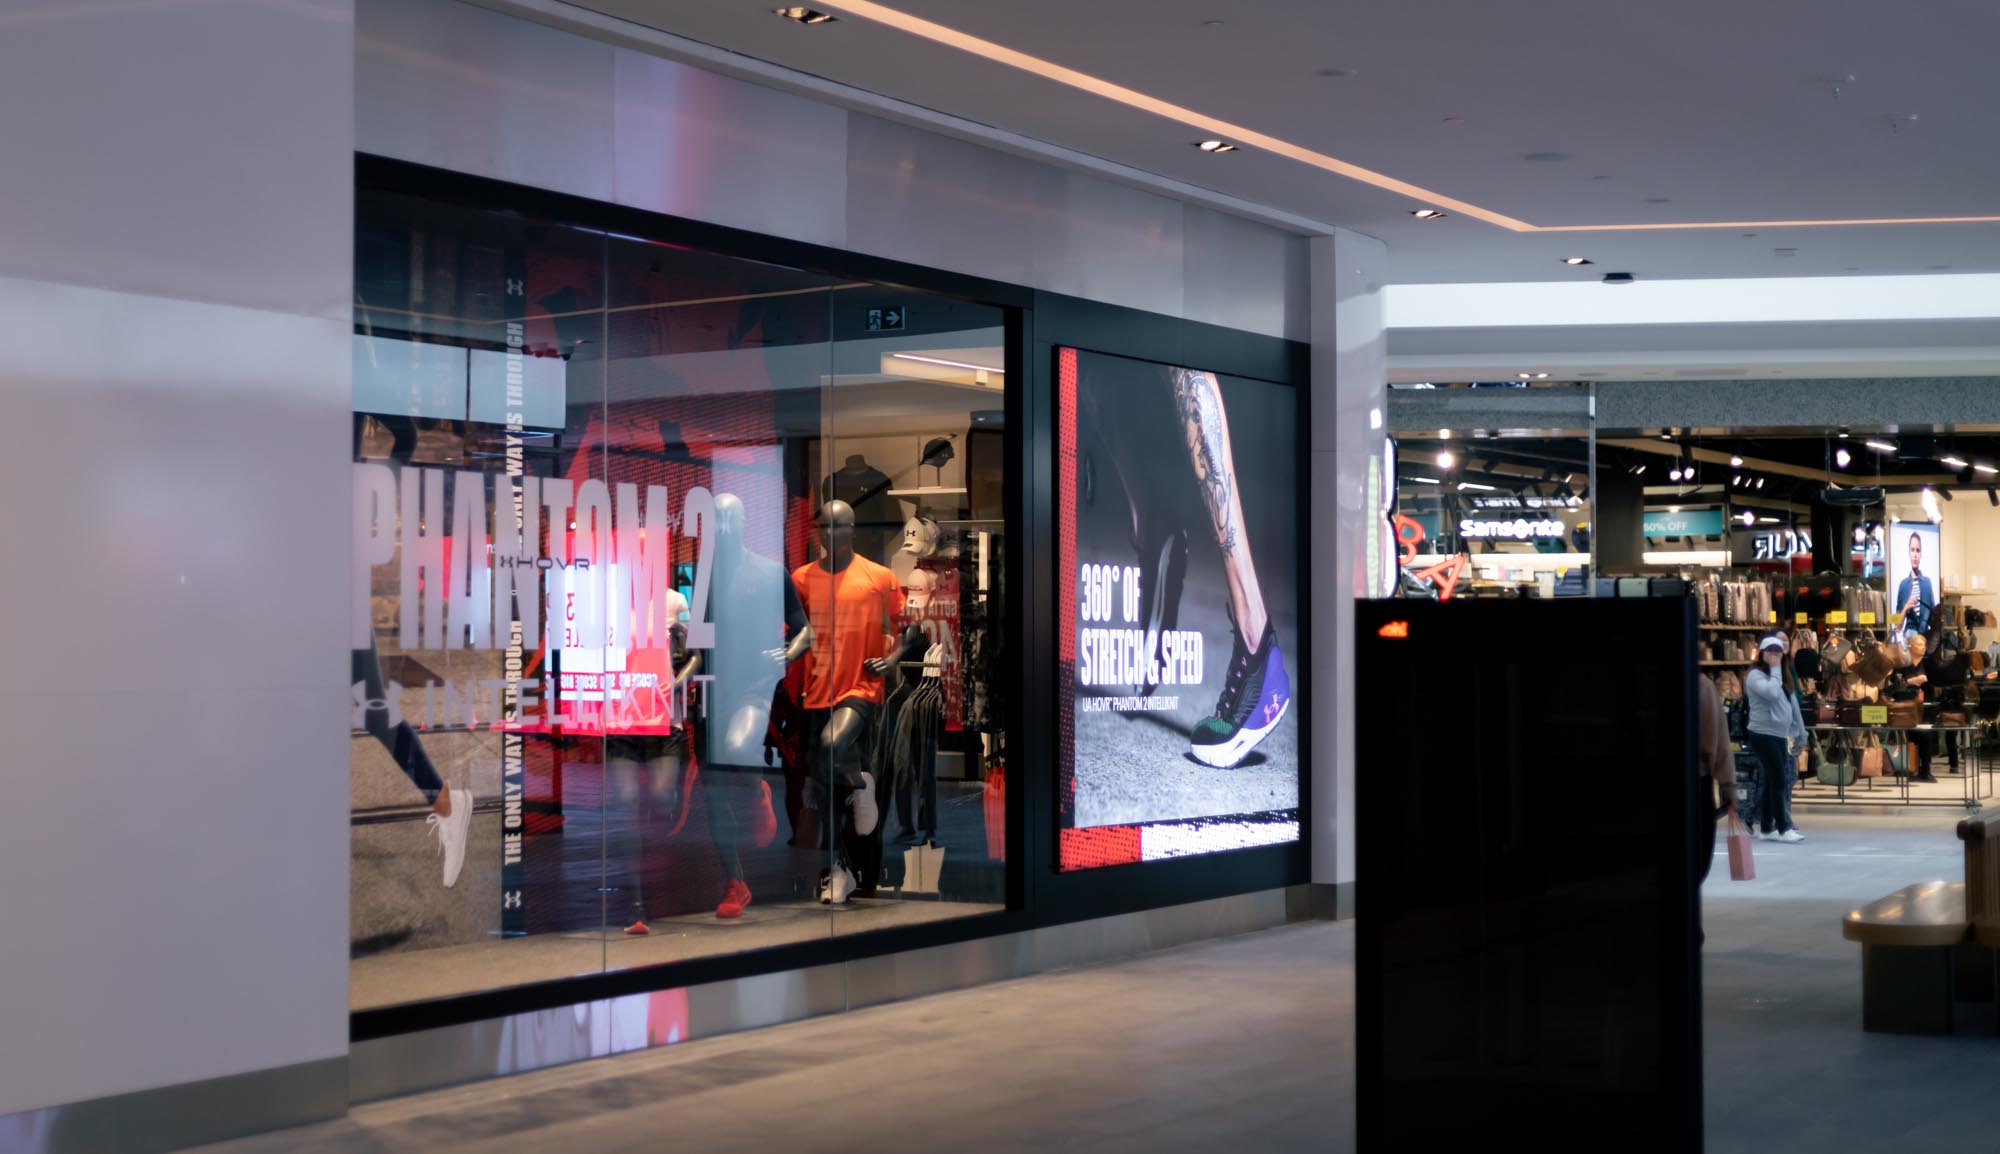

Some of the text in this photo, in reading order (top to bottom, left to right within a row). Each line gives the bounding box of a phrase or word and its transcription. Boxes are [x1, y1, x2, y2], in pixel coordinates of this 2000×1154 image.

[506, 322, 523, 407] THROUGH
[506, 435, 523, 476] WAY
[1460, 518, 1565, 539] Samsonite
[352, 460, 715, 649] PHANTOM 2
[517, 555, 590, 571] HOVR
[1123, 566, 1141, 622] OF
[1081, 628, 1203, 685] STRETCH & SPEED
[1113, 696, 1142, 711] PHANTOM
[505, 733, 521, 776] WAY
[505, 781, 521, 828] ONLY
[505, 832, 521, 866] THE
